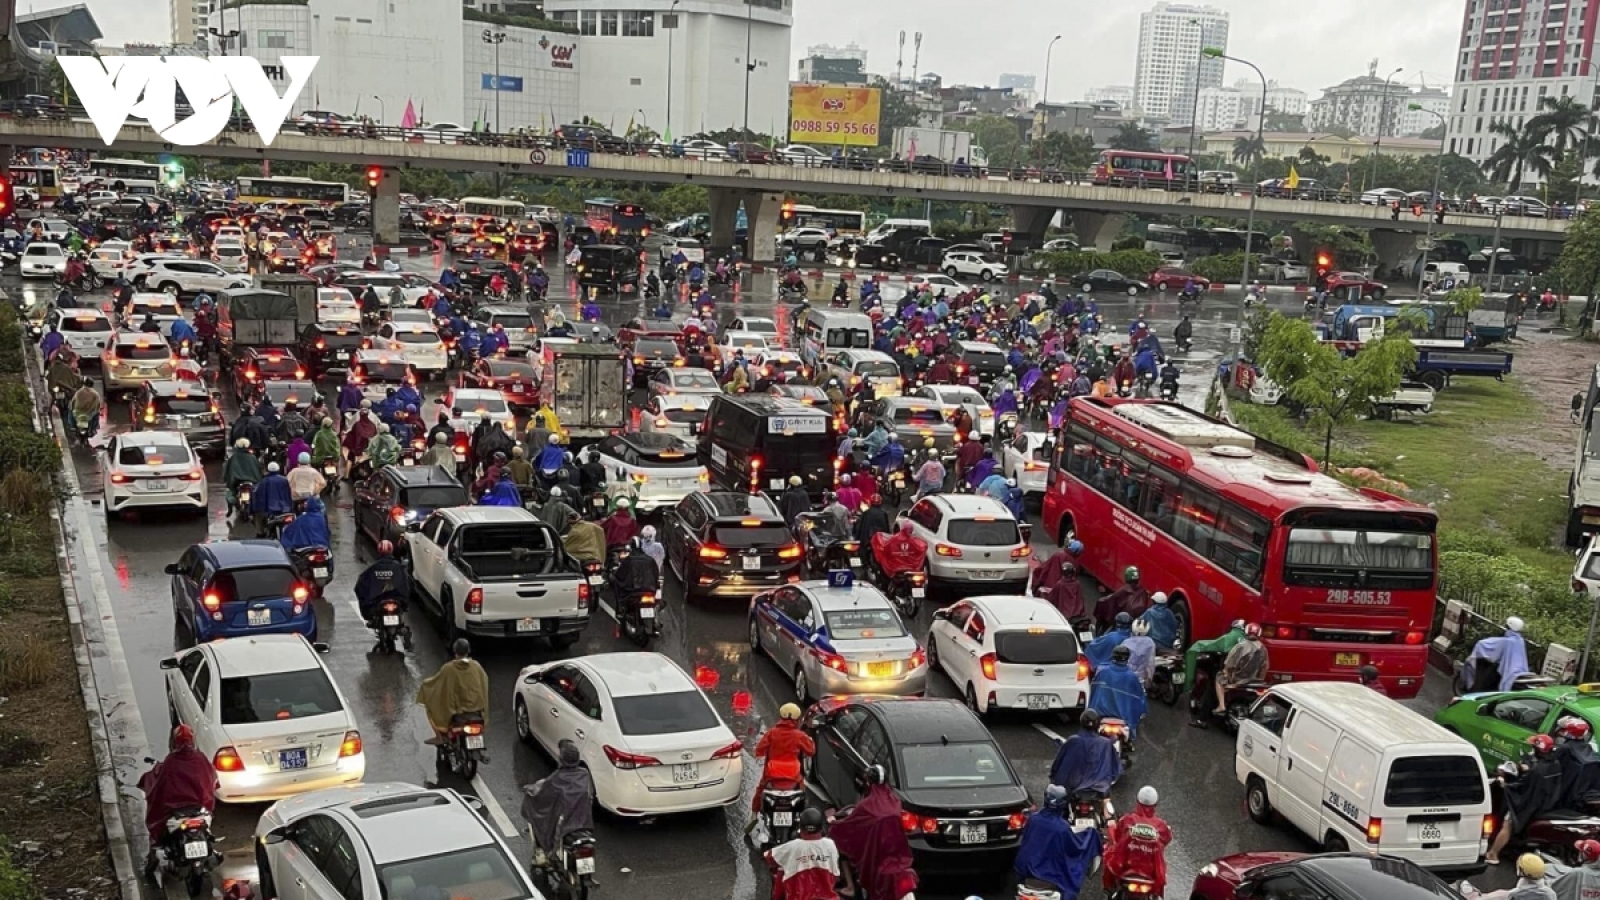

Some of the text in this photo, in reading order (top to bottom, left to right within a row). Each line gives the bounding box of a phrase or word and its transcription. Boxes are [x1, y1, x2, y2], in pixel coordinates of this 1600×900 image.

[552, 45, 573, 60] CGV
[793, 120, 877, 136] 0988 59 55 66
[1327, 589, 1391, 605] 29B-505.53
